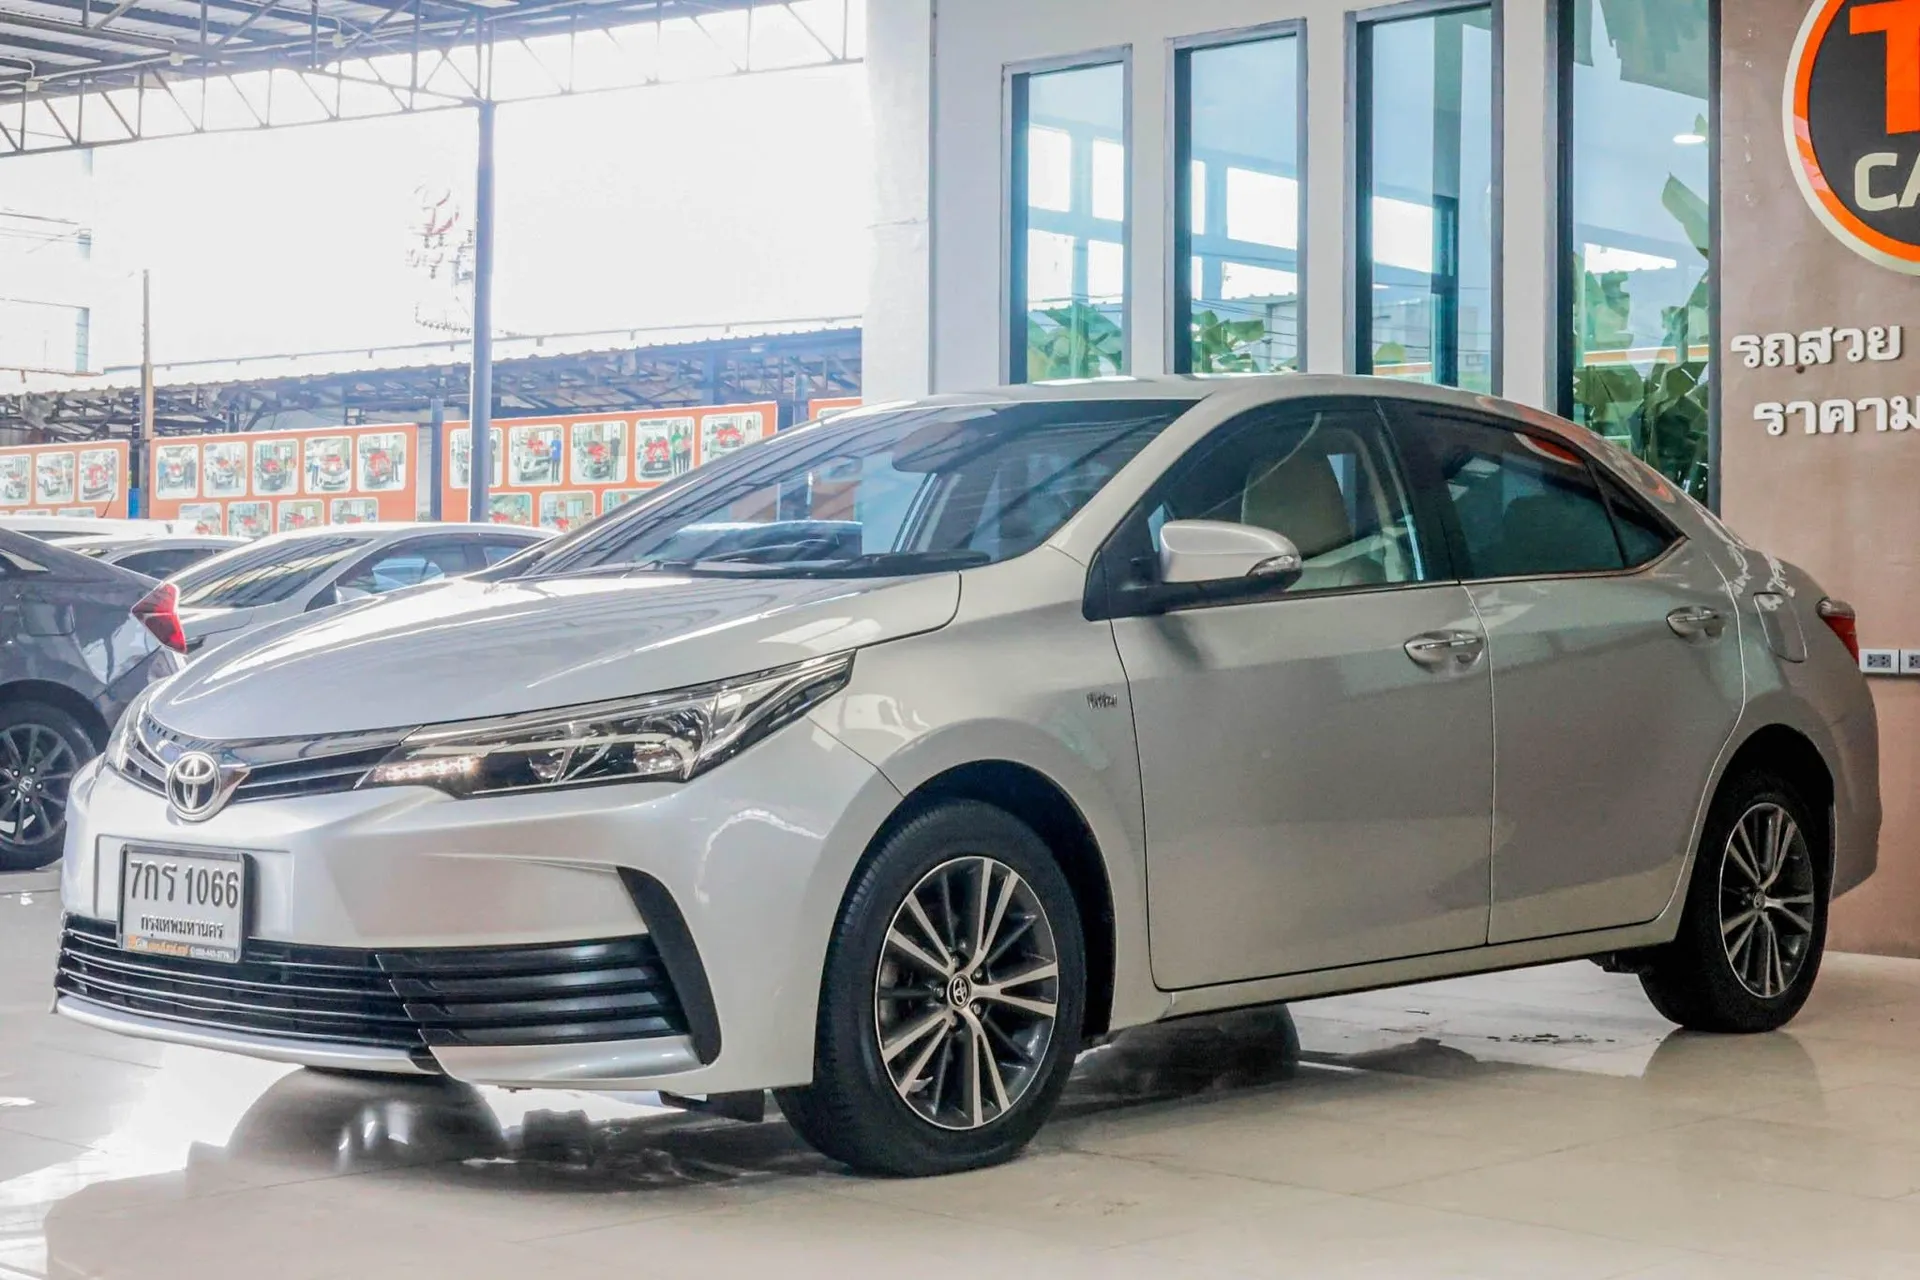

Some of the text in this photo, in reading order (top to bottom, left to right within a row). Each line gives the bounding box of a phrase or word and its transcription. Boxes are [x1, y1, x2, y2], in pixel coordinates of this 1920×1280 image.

[1730, 325, 1902, 369] รถสวย
[184, 865, 239, 909] 1066
[140, 914, 224, 939] กรุงเทพมหานคร
